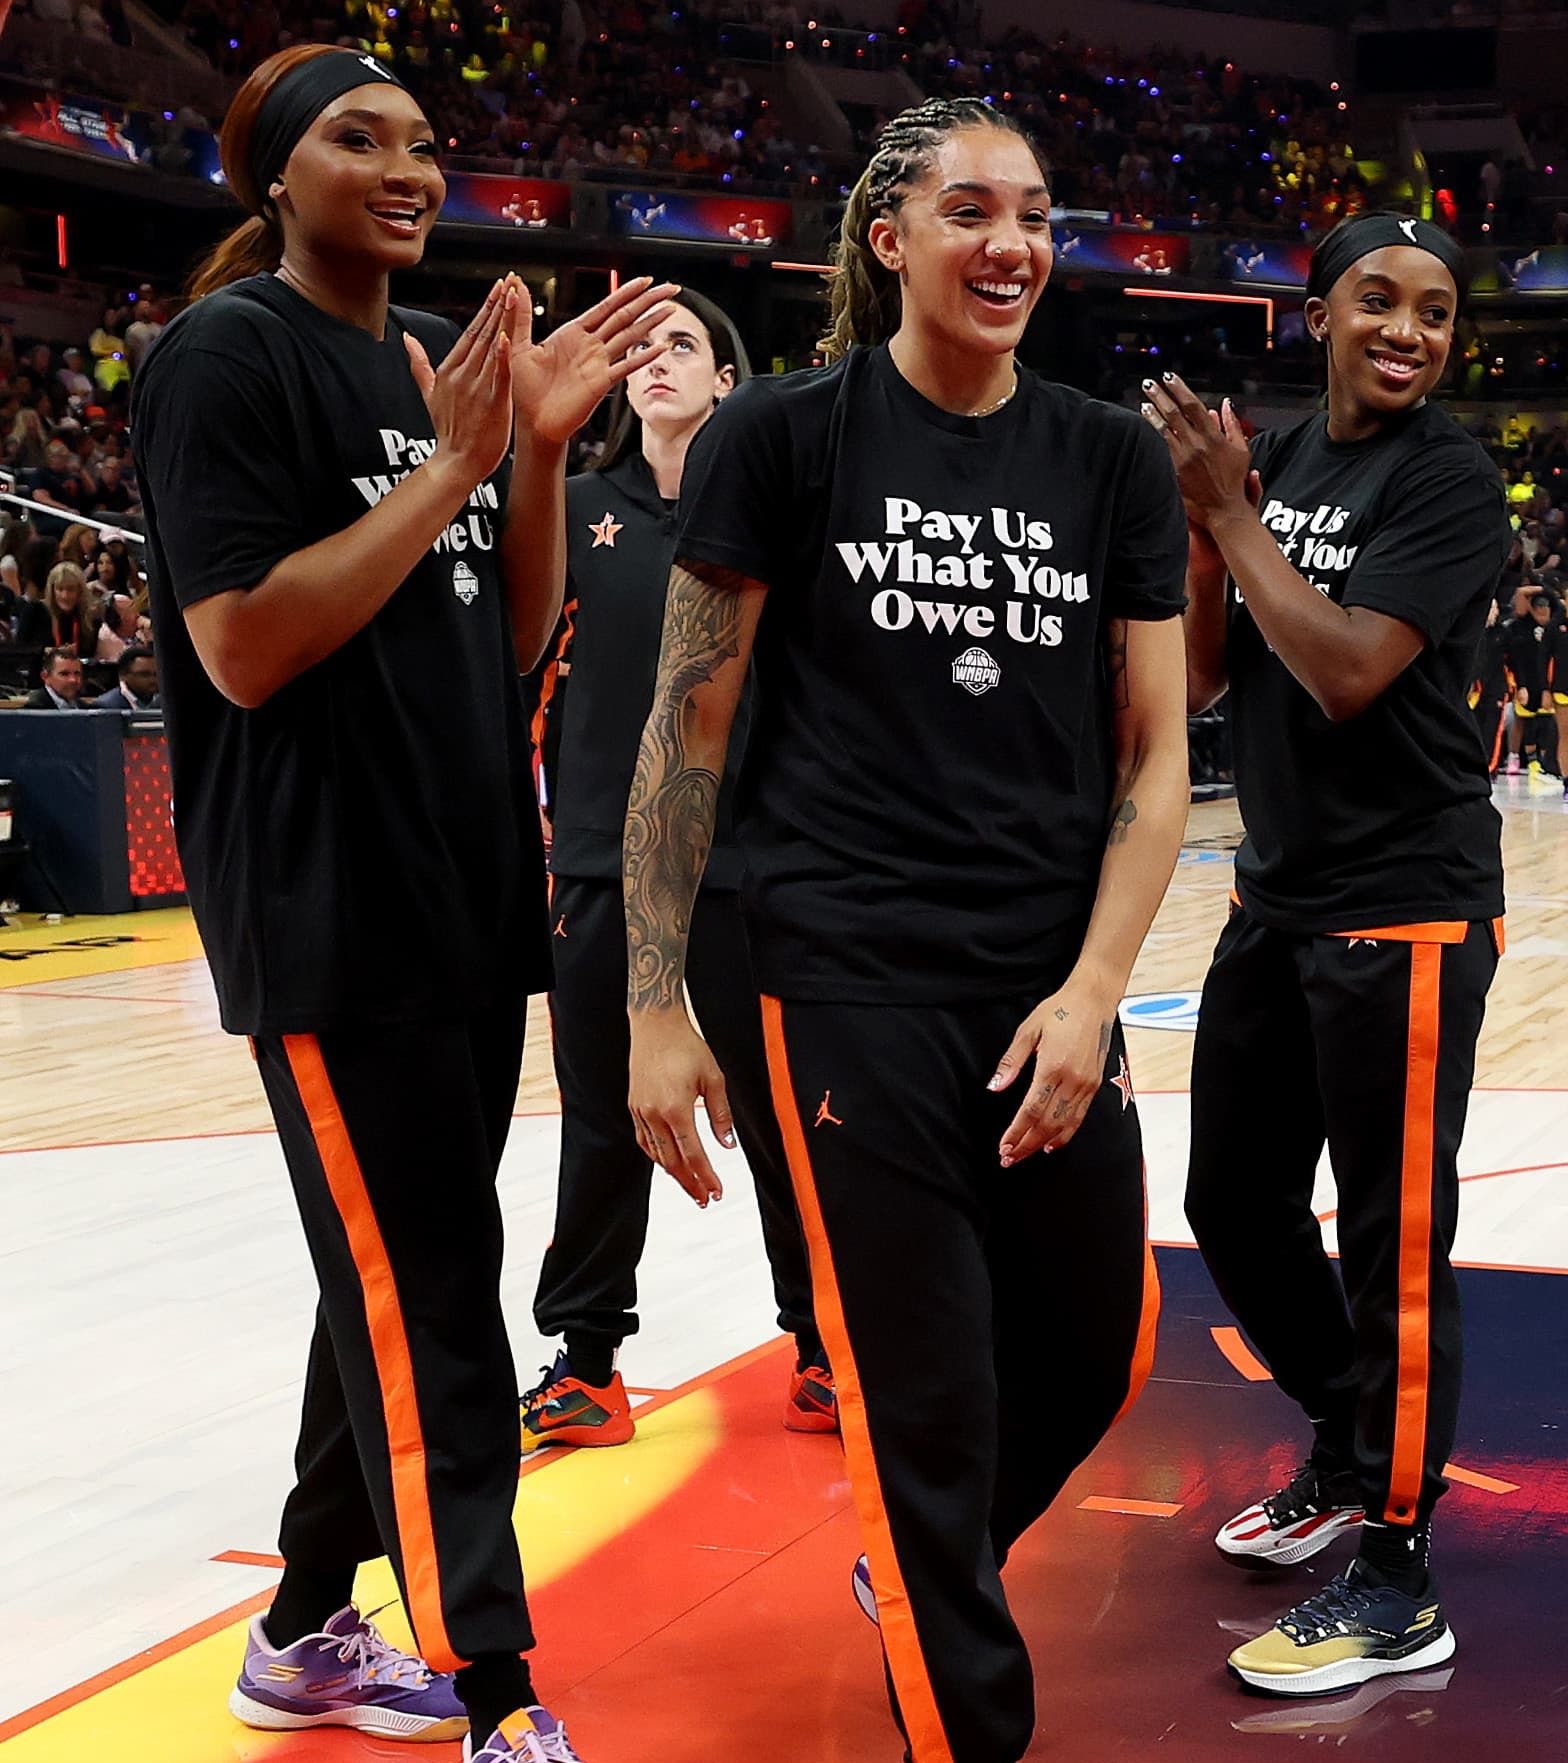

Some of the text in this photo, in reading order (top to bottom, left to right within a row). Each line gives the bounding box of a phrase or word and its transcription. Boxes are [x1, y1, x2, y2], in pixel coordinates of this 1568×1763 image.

[885, 497, 1053, 554] Pay Us
[1261, 499, 1351, 542] Pay Us
[835, 539, 1091, 603] What You
[1299, 537, 1358, 571] You
[871, 589, 1063, 646] Owe Us
[953, 663, 999, 686] WNBPA
